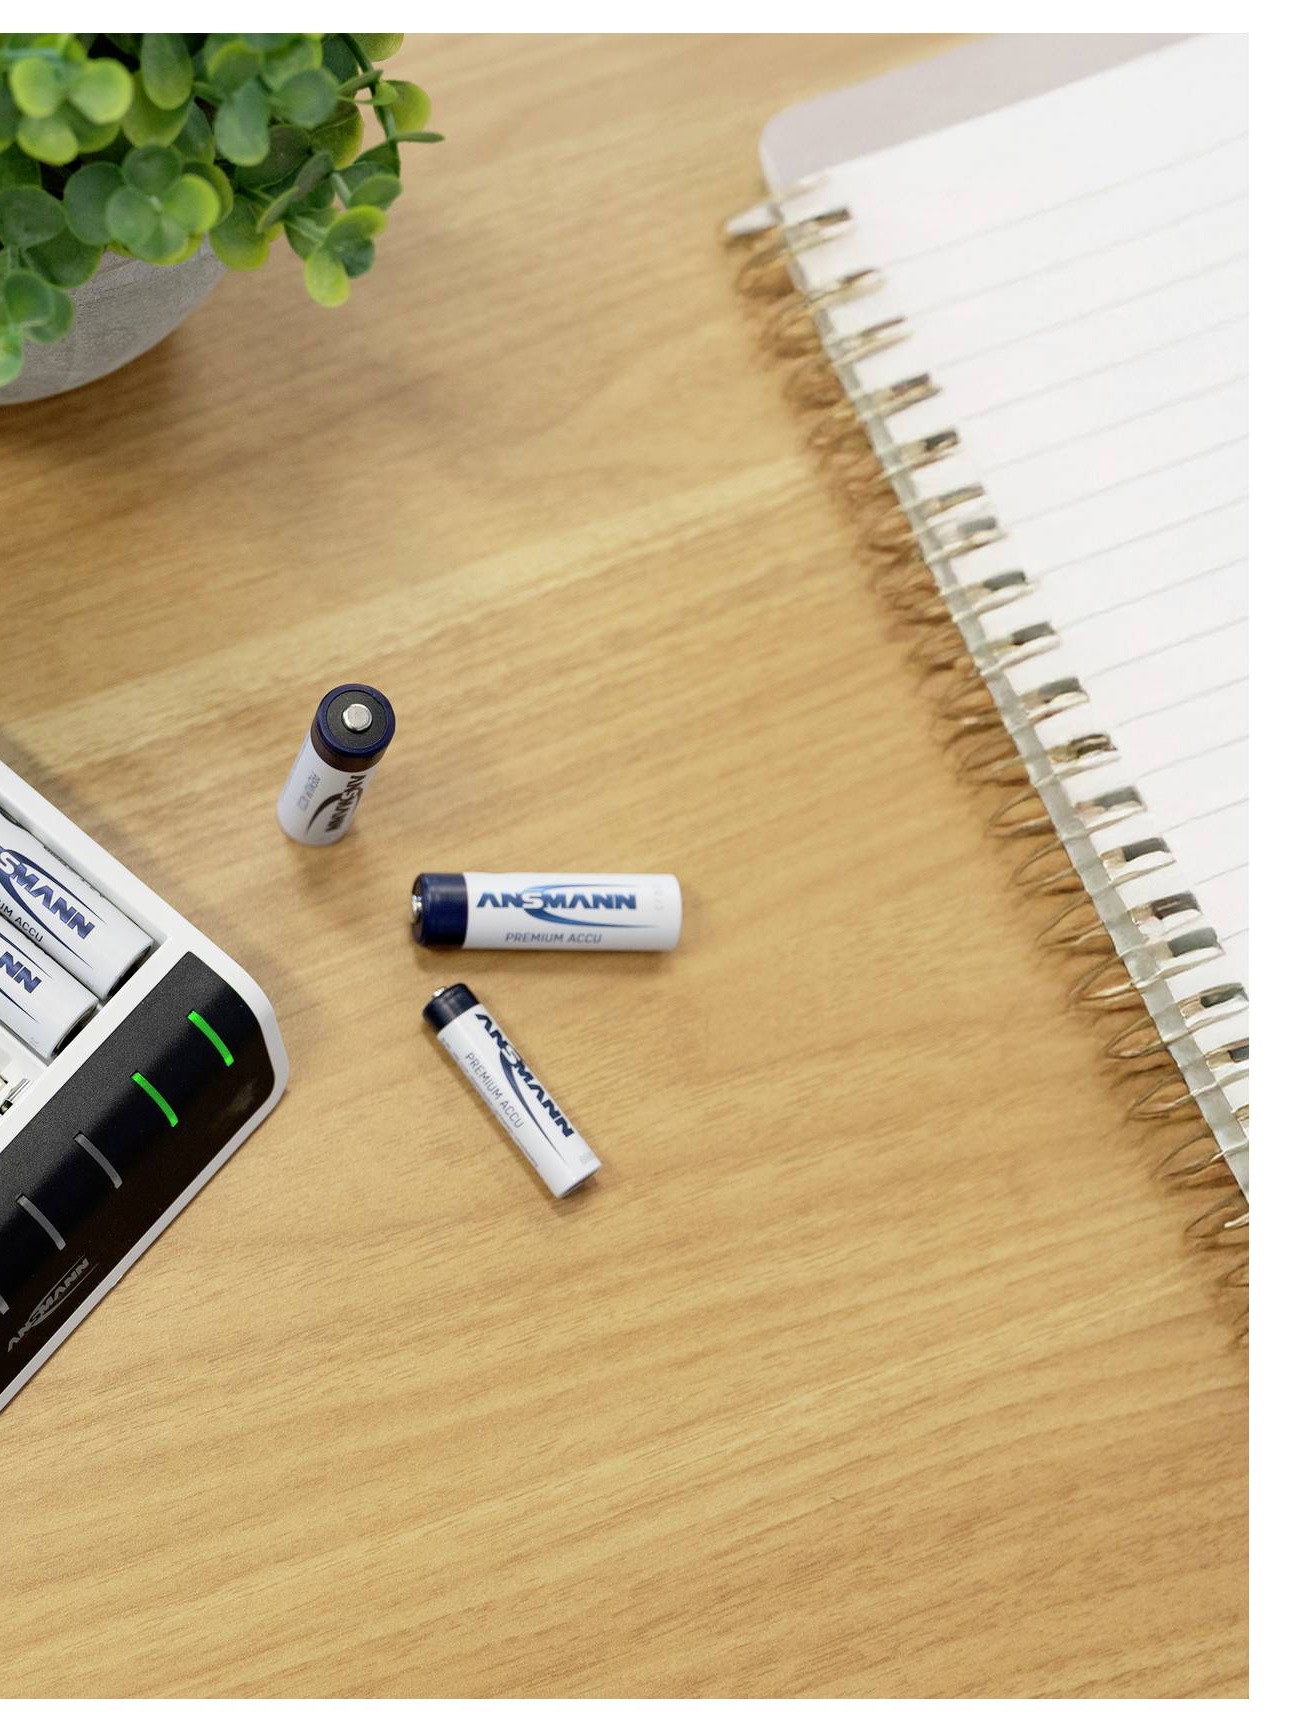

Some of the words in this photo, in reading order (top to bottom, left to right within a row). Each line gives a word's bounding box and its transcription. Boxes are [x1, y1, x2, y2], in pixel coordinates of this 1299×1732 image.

[476, 891, 637, 910] ANSMANN
[14, 915, 44, 943] ACCU
[505, 932, 564, 944] PREMIUM
[568, 933, 603, 945] ACCU
[465, 1052, 503, 1100] PREMIUM
[501, 1100, 525, 1129] ACCU
[475, 1013, 575, 1138] ANSMANN
[7, 1257, 90, 1353] ANSMANN
